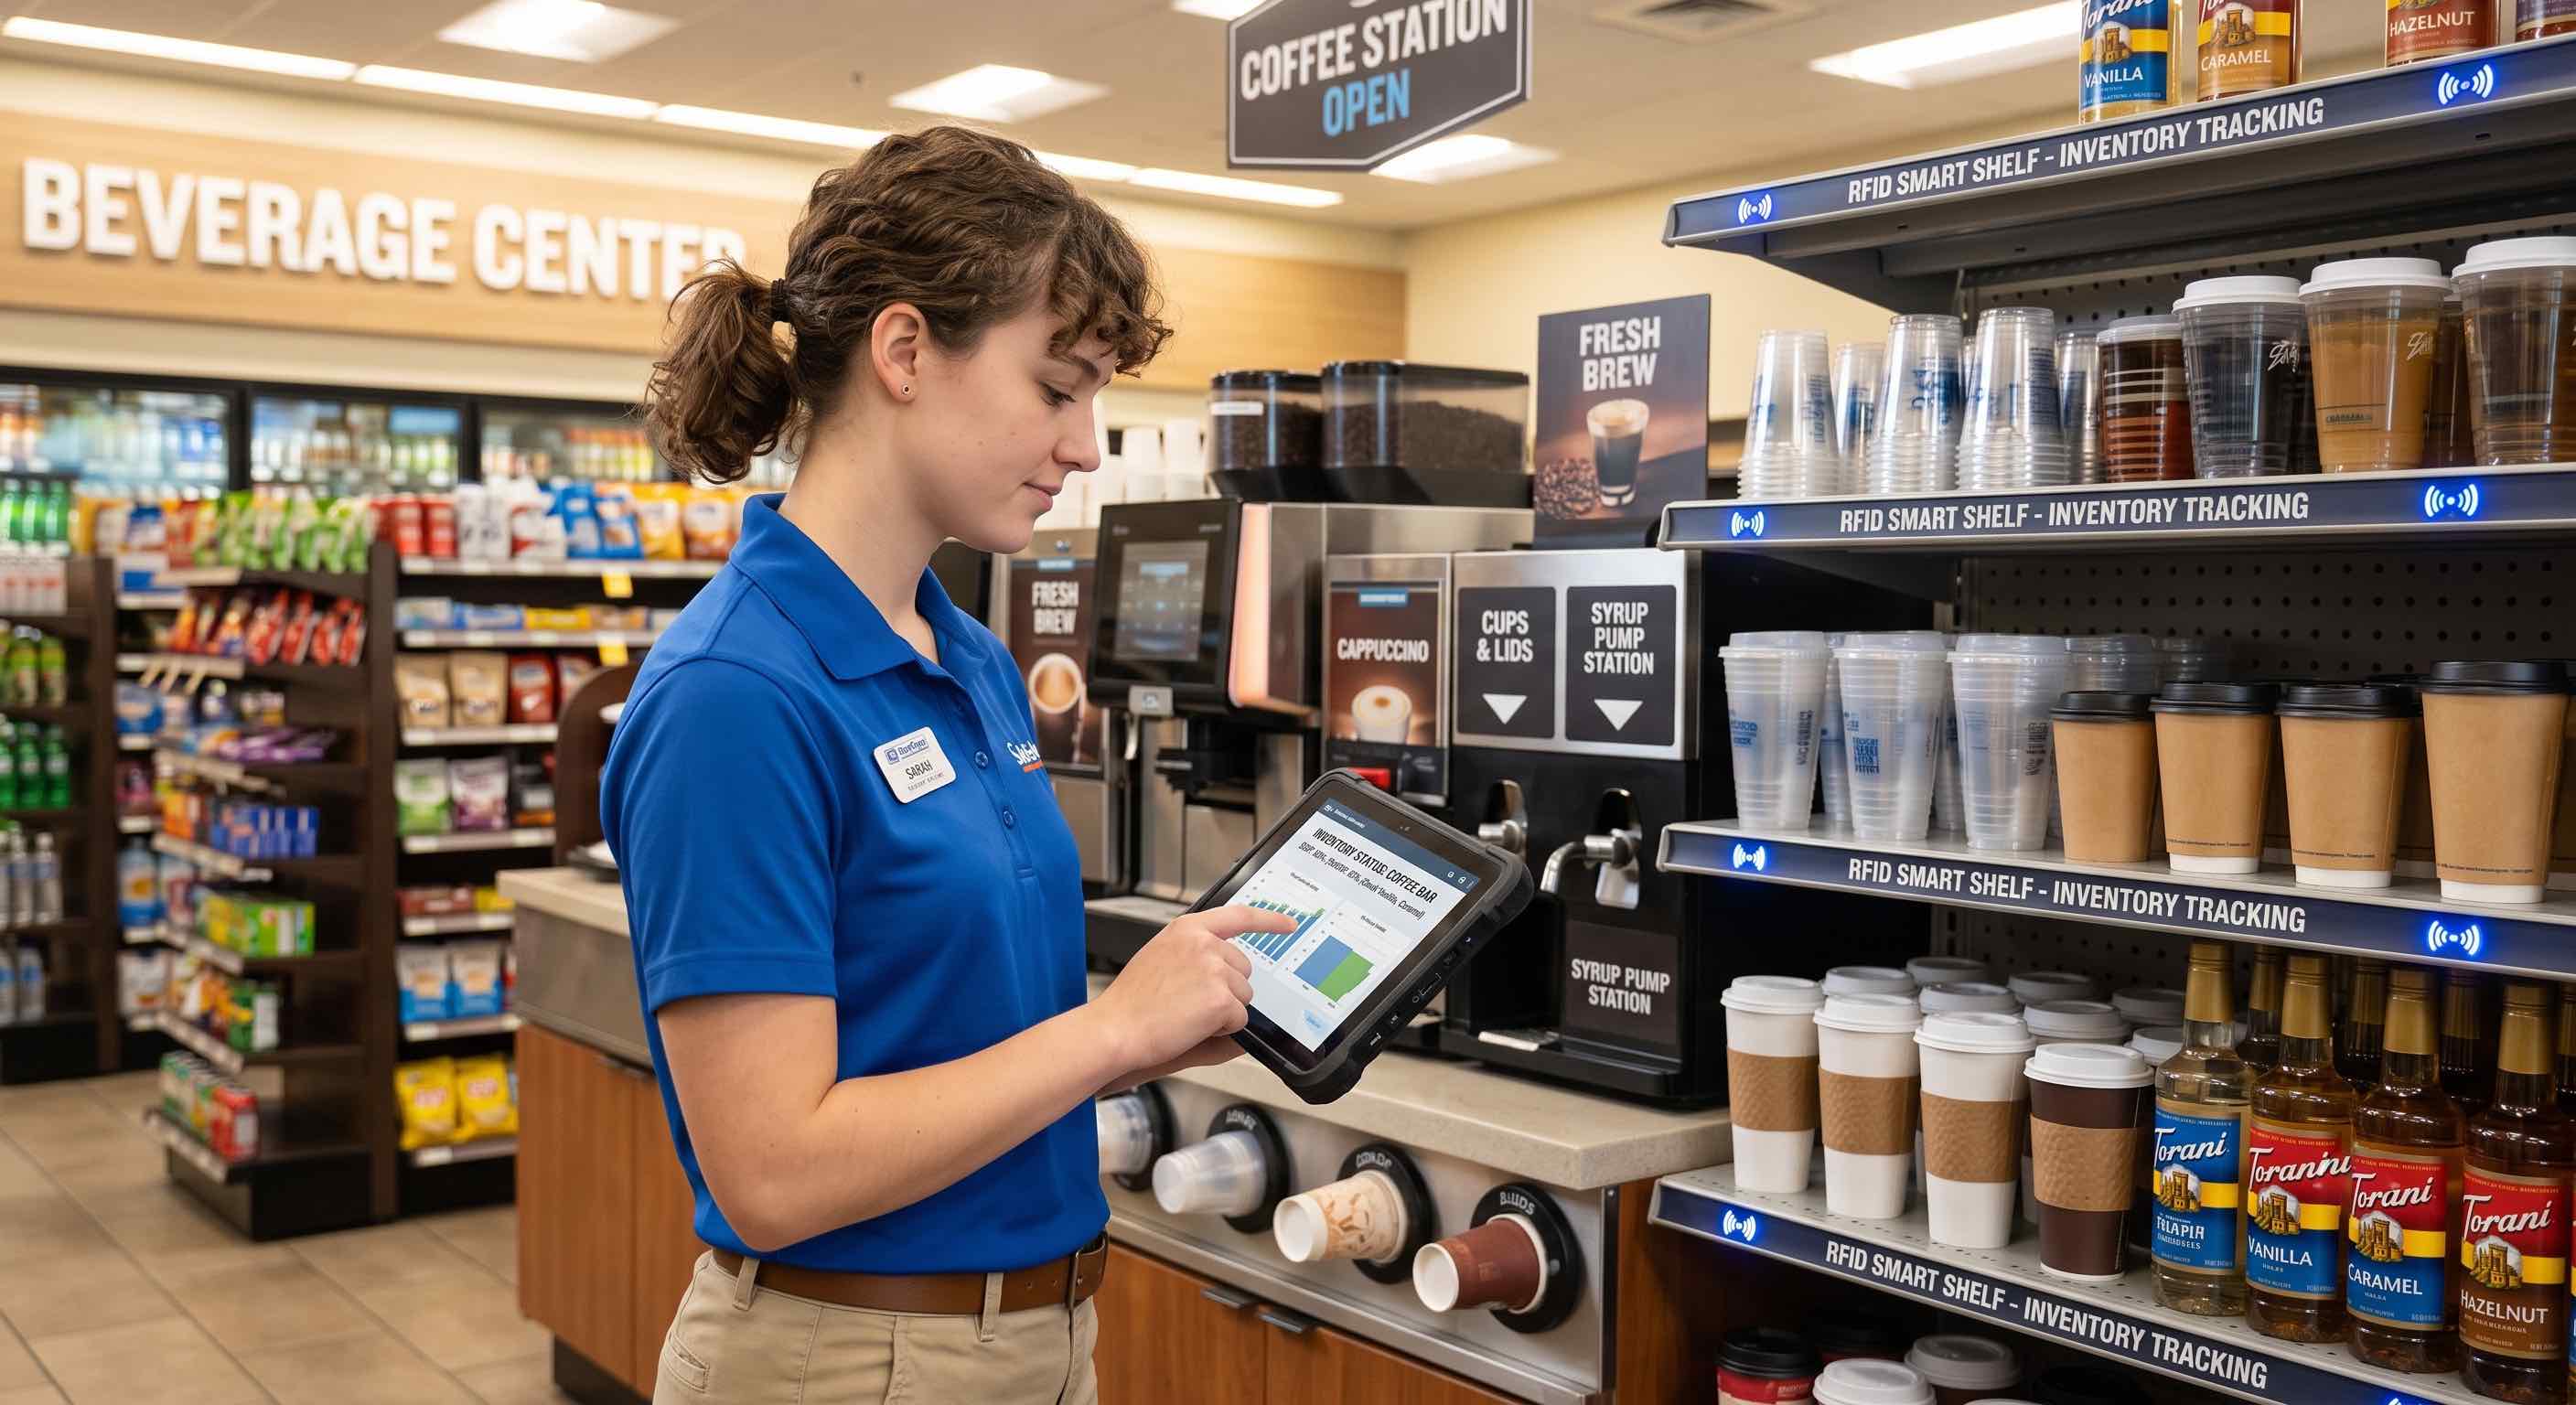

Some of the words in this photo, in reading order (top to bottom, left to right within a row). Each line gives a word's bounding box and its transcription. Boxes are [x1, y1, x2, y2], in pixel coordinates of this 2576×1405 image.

[2390, 11, 2475, 37] HAZELNUT
[1240, 23, 1356, 101] COFFEE
[1361, 0, 1508, 68] STATION
[2201, 49, 2271, 71] CARAMEL
[2085, 67, 2143, 88] VANILLA
[1323, 69, 1411, 137] OPEN
[1848, 175, 1892, 204] RFID
[1896, 160, 1968, 195] SMART
[1972, 147, 2040, 183] SHELF
[2059, 121, 2192, 167] INVENTORY
[2196, 97, 2324, 144] TRACKING
[23, 156, 456, 283] BEVERAGE
[1579, 316, 1661, 357] FRESH
[1583, 352, 1658, 391] BREW
[1840, 509, 1884, 532] RFID
[1888, 506, 1959, 531] SMART
[1962, 503, 2030, 529] SHELF
[2048, 498, 2178, 526] INVENTORY
[2184, 491, 2309, 522] TRACKING
[1032, 581, 1079, 607] FRESH
[1034, 608, 1077, 634] BREW
[1481, 610, 1530, 635] CUPS
[1591, 602, 1648, 625] SYRUP
[1337, 638, 1429, 662] CAPPUCCINO
[1476, 638, 1491, 662] &
[1494, 638, 1534, 662] LIDS
[1594, 627, 1646, 649] PUMP
[1583, 651, 1654, 675] STATION
[906, 759, 933, 780] SARAH
[1386, 869, 1421, 897] COFFEE
[1415, 885, 1438, 904] BAR
[1848, 858, 1892, 884] RFID
[1896, 863, 1966, 893] SMART
[1969, 871, 2034, 900] SHELF
[2053, 880, 2180, 921] INVENTORY
[2184, 895, 2306, 933] TRACKING
[1572, 959, 1621, 985] SYRUP
[1625, 967, 1670, 993] PUMP
[1588, 984, 1651, 1015] STATION
[2153, 1127, 2227, 1171] Torani
[2351, 1172, 2434, 1216] Torani
[2463, 1195, 2552, 1242] Torani
[2248, 1235, 2313, 1267] VANILLA
[2348, 1262, 2423, 1295] CARAMEL
[1826, 1239, 1867, 1271] RFID
[1872, 1253, 1939, 1292] SMART
[1942, 1273, 2006, 1311] SHELF
[2023, 1296, 2145, 1352] INVENTORY
[2151, 1332, 2268, 1389] TRACKING
[2461, 1289, 2549, 1325] HAZELNUT
